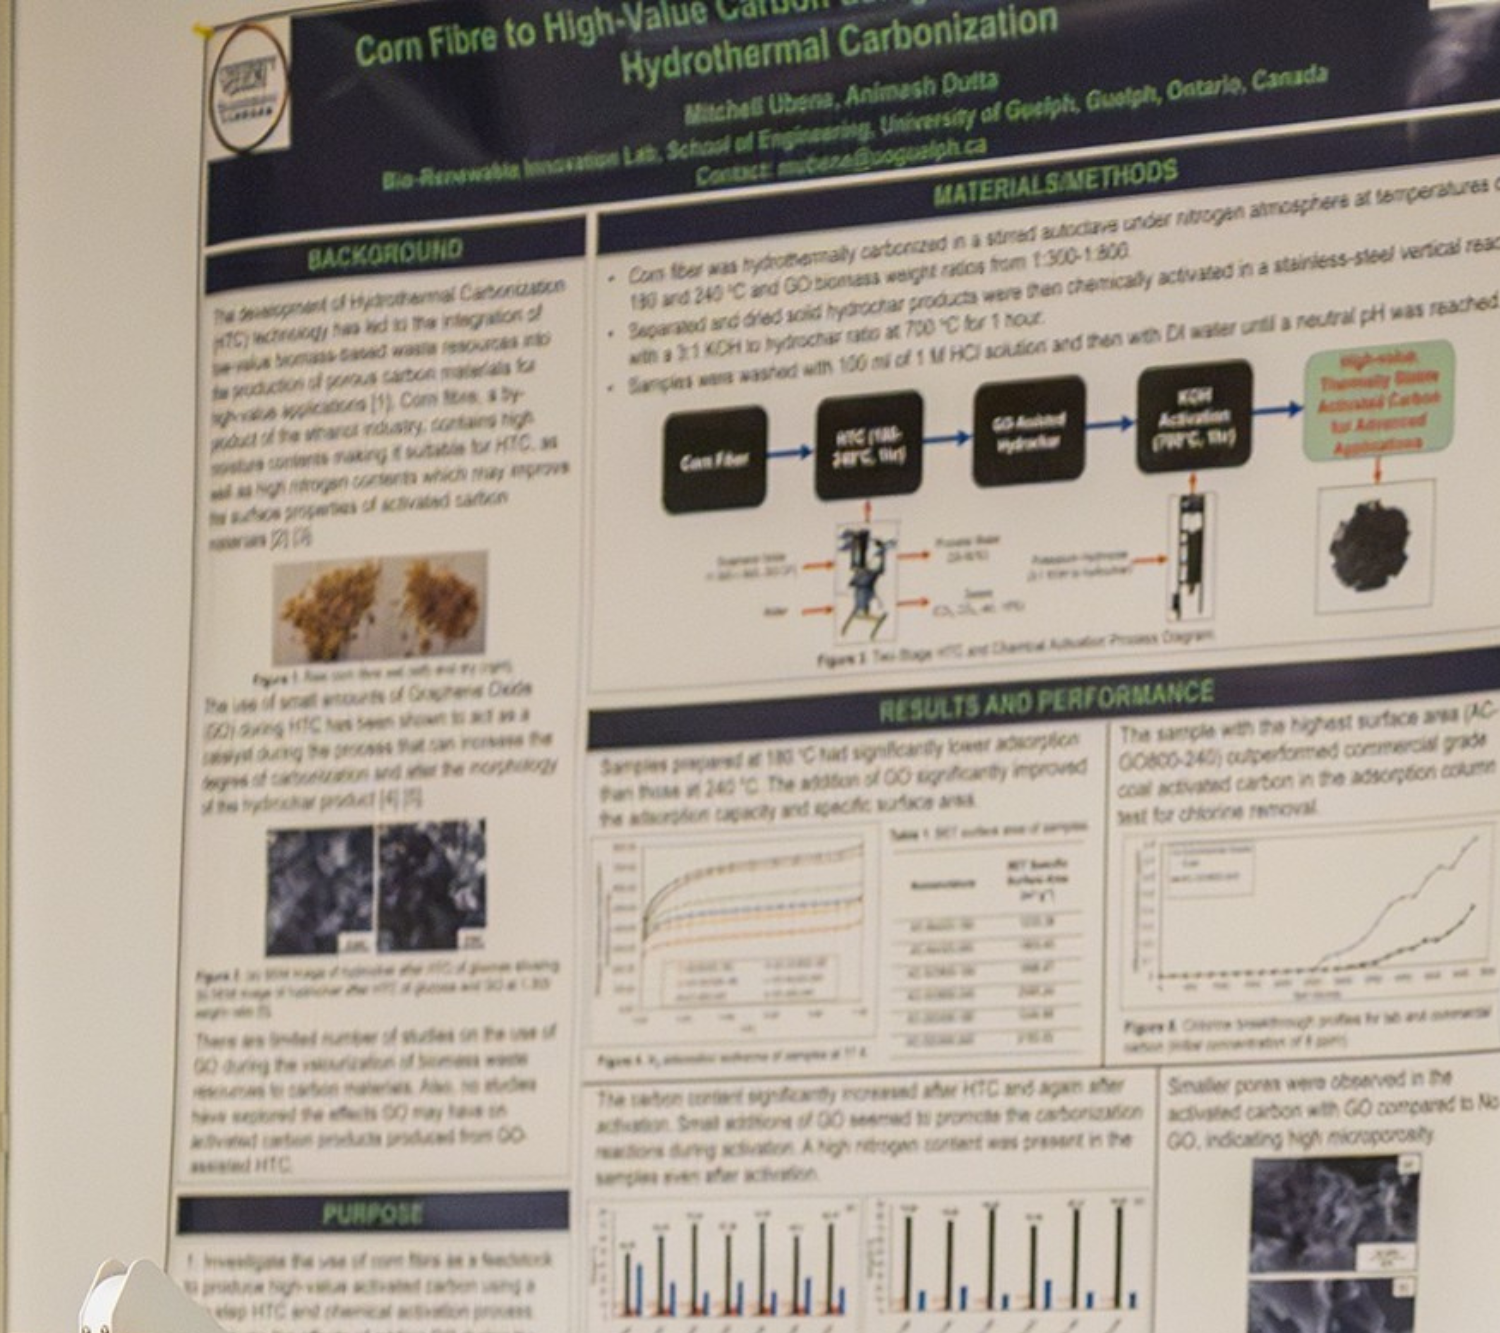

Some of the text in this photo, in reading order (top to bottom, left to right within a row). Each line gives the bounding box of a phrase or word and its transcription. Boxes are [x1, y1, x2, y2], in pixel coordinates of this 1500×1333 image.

[357, 5, 701, 69] Corn Fibre to High-Value
[620, 7, 1060, 90] Hydrothermal Carbonization
[942, 69, 999, 97] Dutta
[667, 134, 730, 162] School
[734, 132, 756, 154] of
[880, 107, 977, 138] University
[981, 102, 1002, 125] of
[1252, 63, 1330, 93] Canada
[933, 157, 1179, 208] MATERIALS/METHODS
[308, 239, 463, 271] BACKGROUND
[879, 679, 1215, 723] RESULTS AND PERFORMANCE
[322, 1203, 424, 1225] PURPOSE
